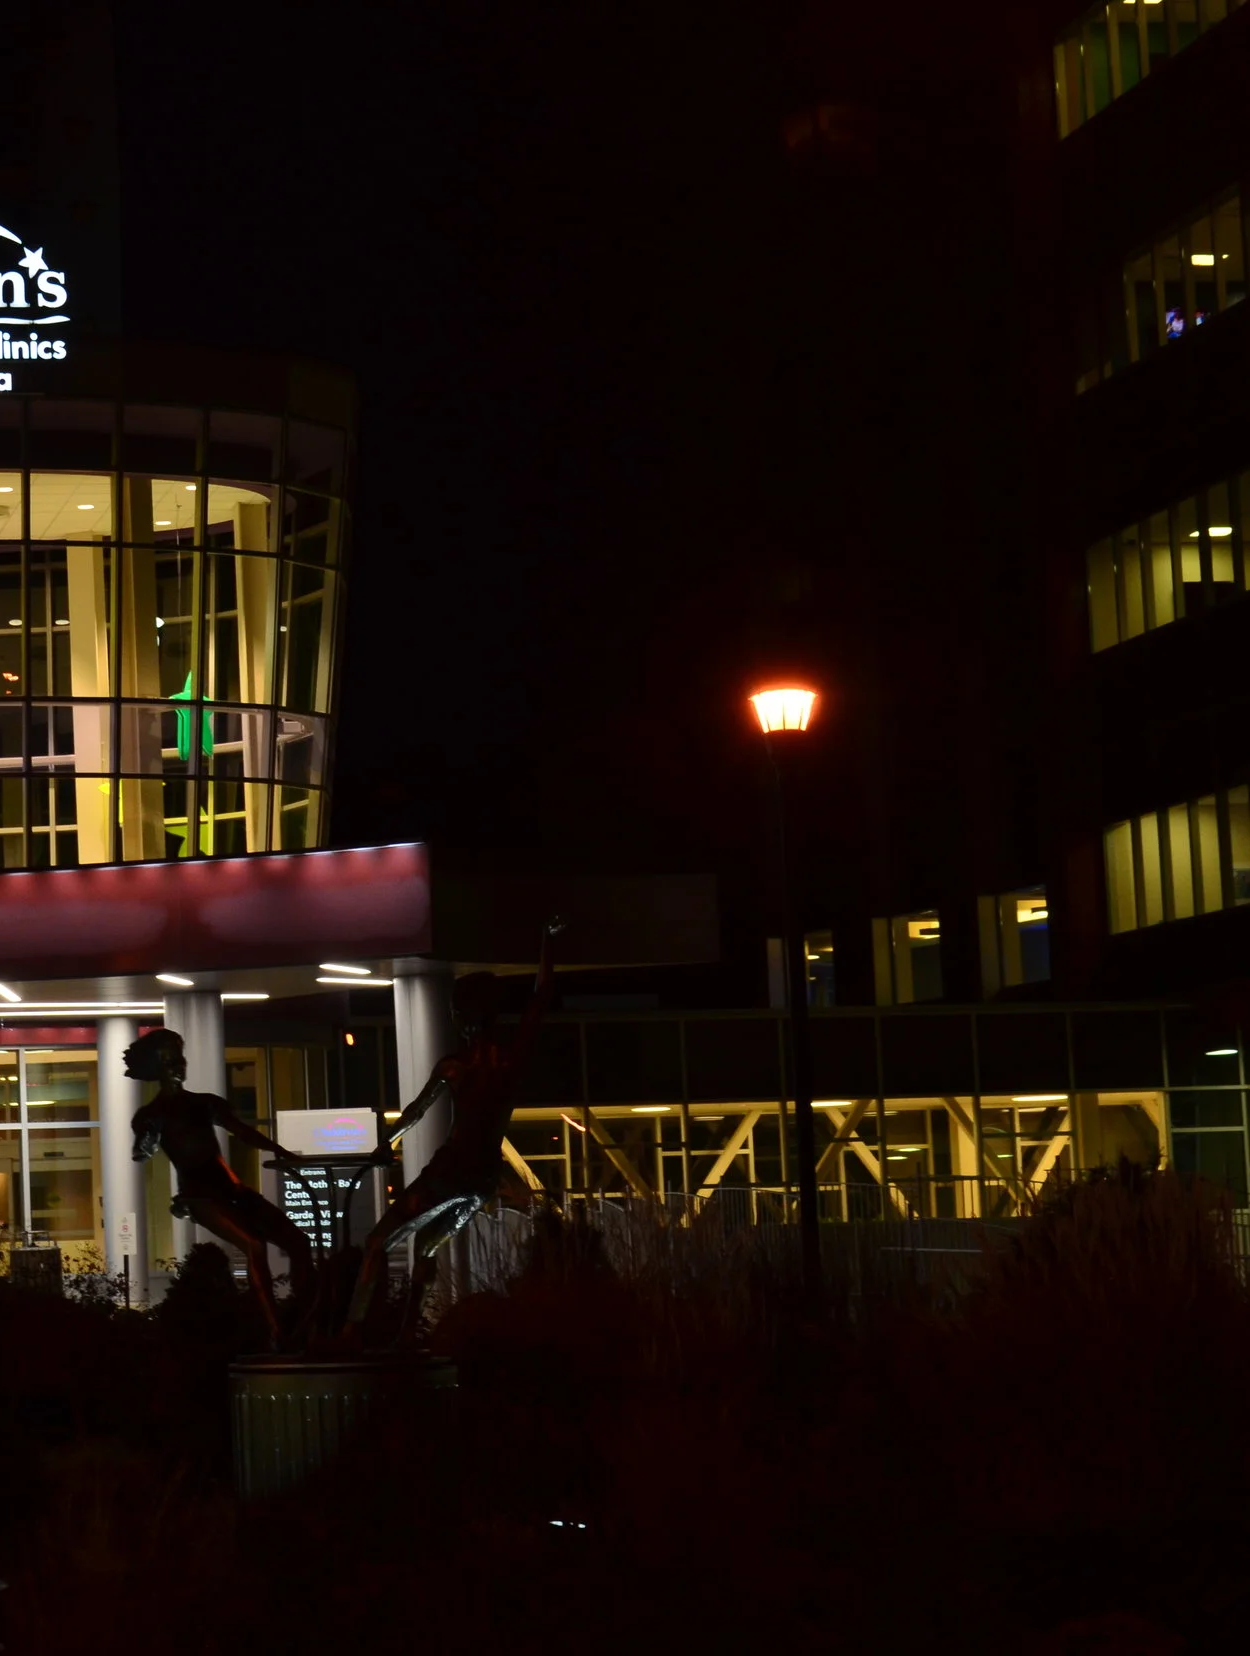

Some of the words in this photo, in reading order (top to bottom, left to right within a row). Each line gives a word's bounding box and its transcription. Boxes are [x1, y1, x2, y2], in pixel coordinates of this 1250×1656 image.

[284, 1181, 303, 1190] The
[285, 1210, 315, 1220] Garde
[320, 1209, 344, 1219] Viw
